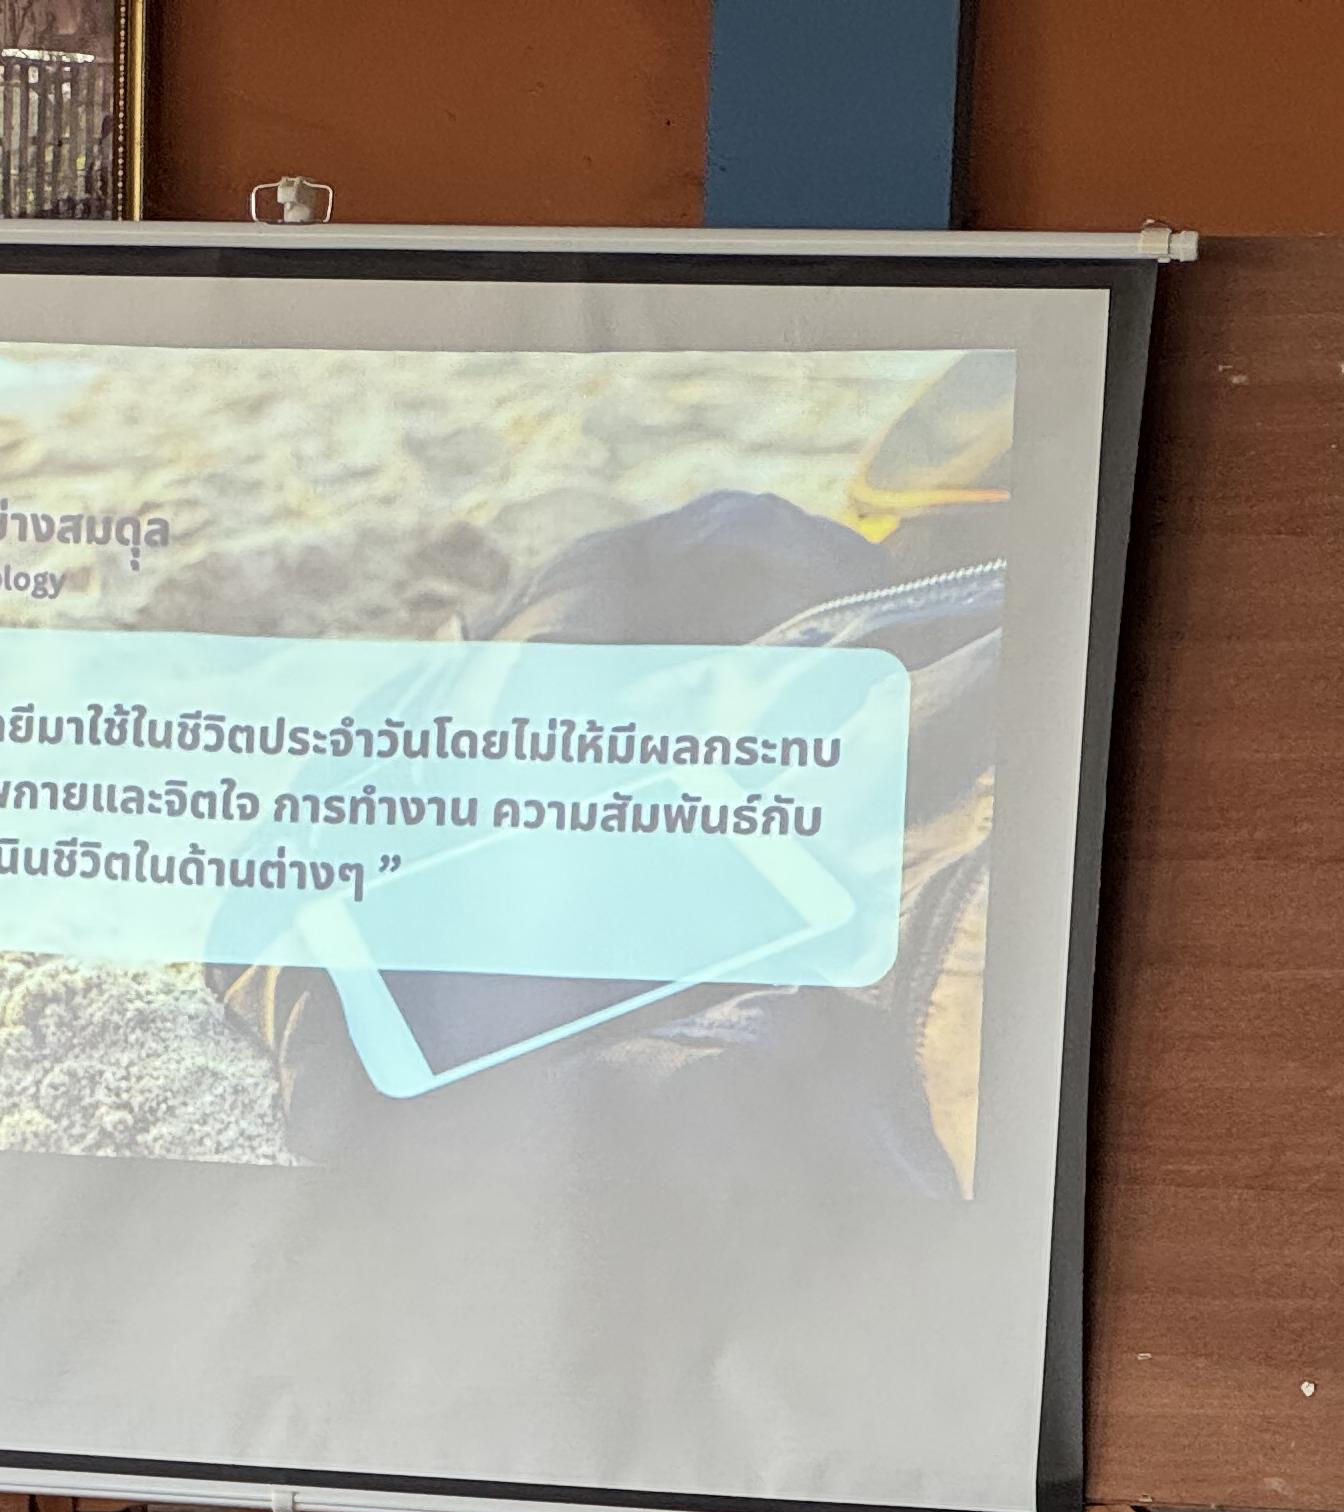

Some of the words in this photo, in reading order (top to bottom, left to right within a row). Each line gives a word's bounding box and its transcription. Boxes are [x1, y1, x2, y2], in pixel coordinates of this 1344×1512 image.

[273, 784, 478, 827] การทำงาน
[493, 791, 822, 836] ความสัมพันธ์กับ
